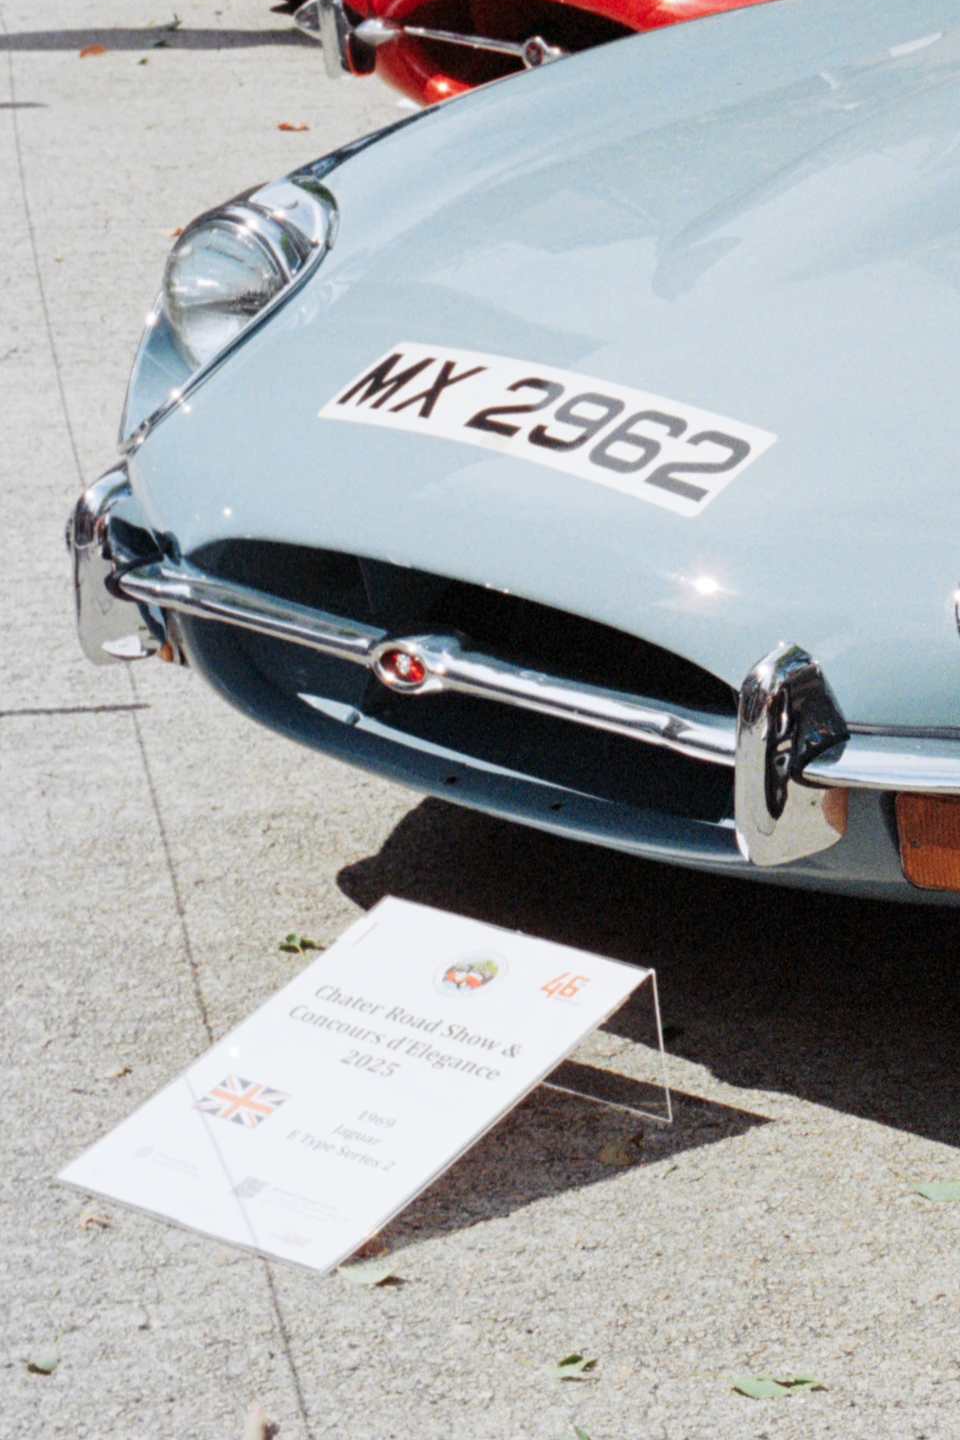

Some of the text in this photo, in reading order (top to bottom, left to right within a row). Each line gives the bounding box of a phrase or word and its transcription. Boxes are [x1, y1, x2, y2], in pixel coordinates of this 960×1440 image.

[336, 353, 752, 504] MX 2962
[288, 1003, 503, 1082] Concours d'Elegance
[313, 983, 524, 1060] Chater Road Show &
[339, 1048, 401, 1078] 2025
[330, 1122, 383, 1148] Jaguar
[356, 1108, 398, 1130] 1969
[285, 1128, 397, 1173] E Type Series 2
